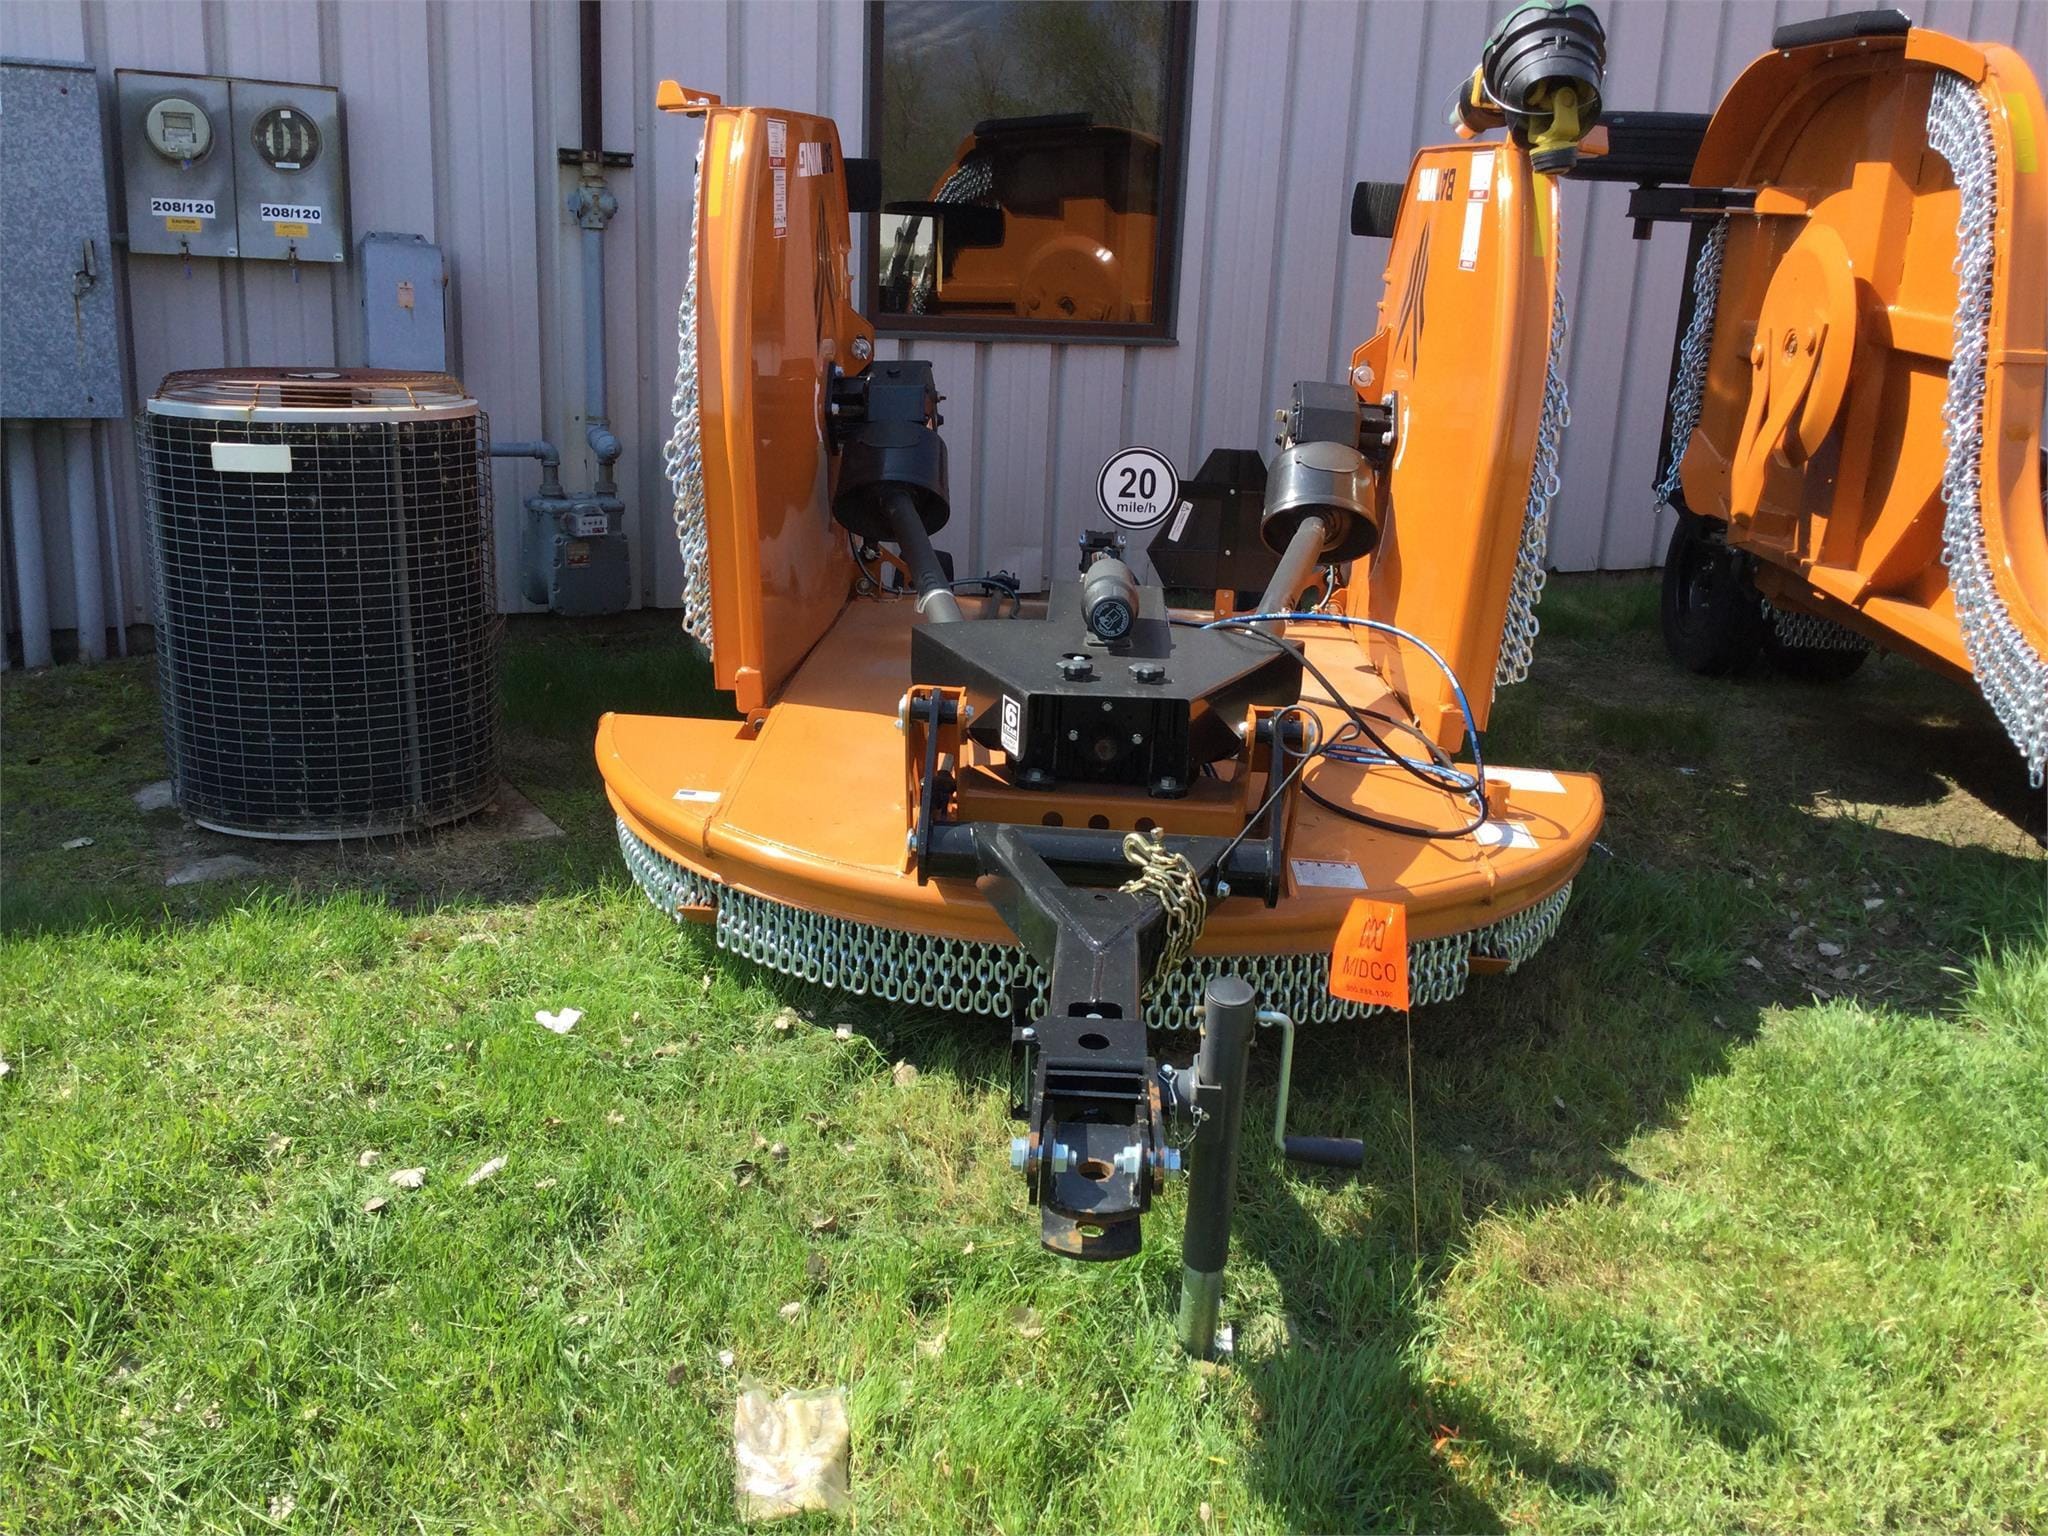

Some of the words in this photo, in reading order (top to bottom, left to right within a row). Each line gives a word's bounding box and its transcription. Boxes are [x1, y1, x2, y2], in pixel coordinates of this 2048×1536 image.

[153, 201, 214, 214] 208/120
[262, 207, 320, 220] 208/120
[1118, 467, 1157, 499] 20
[1116, 502, 1156, 513] mile/h
[1005, 703, 1017, 727] 6
[1343, 955, 1396, 983] MIDCO
